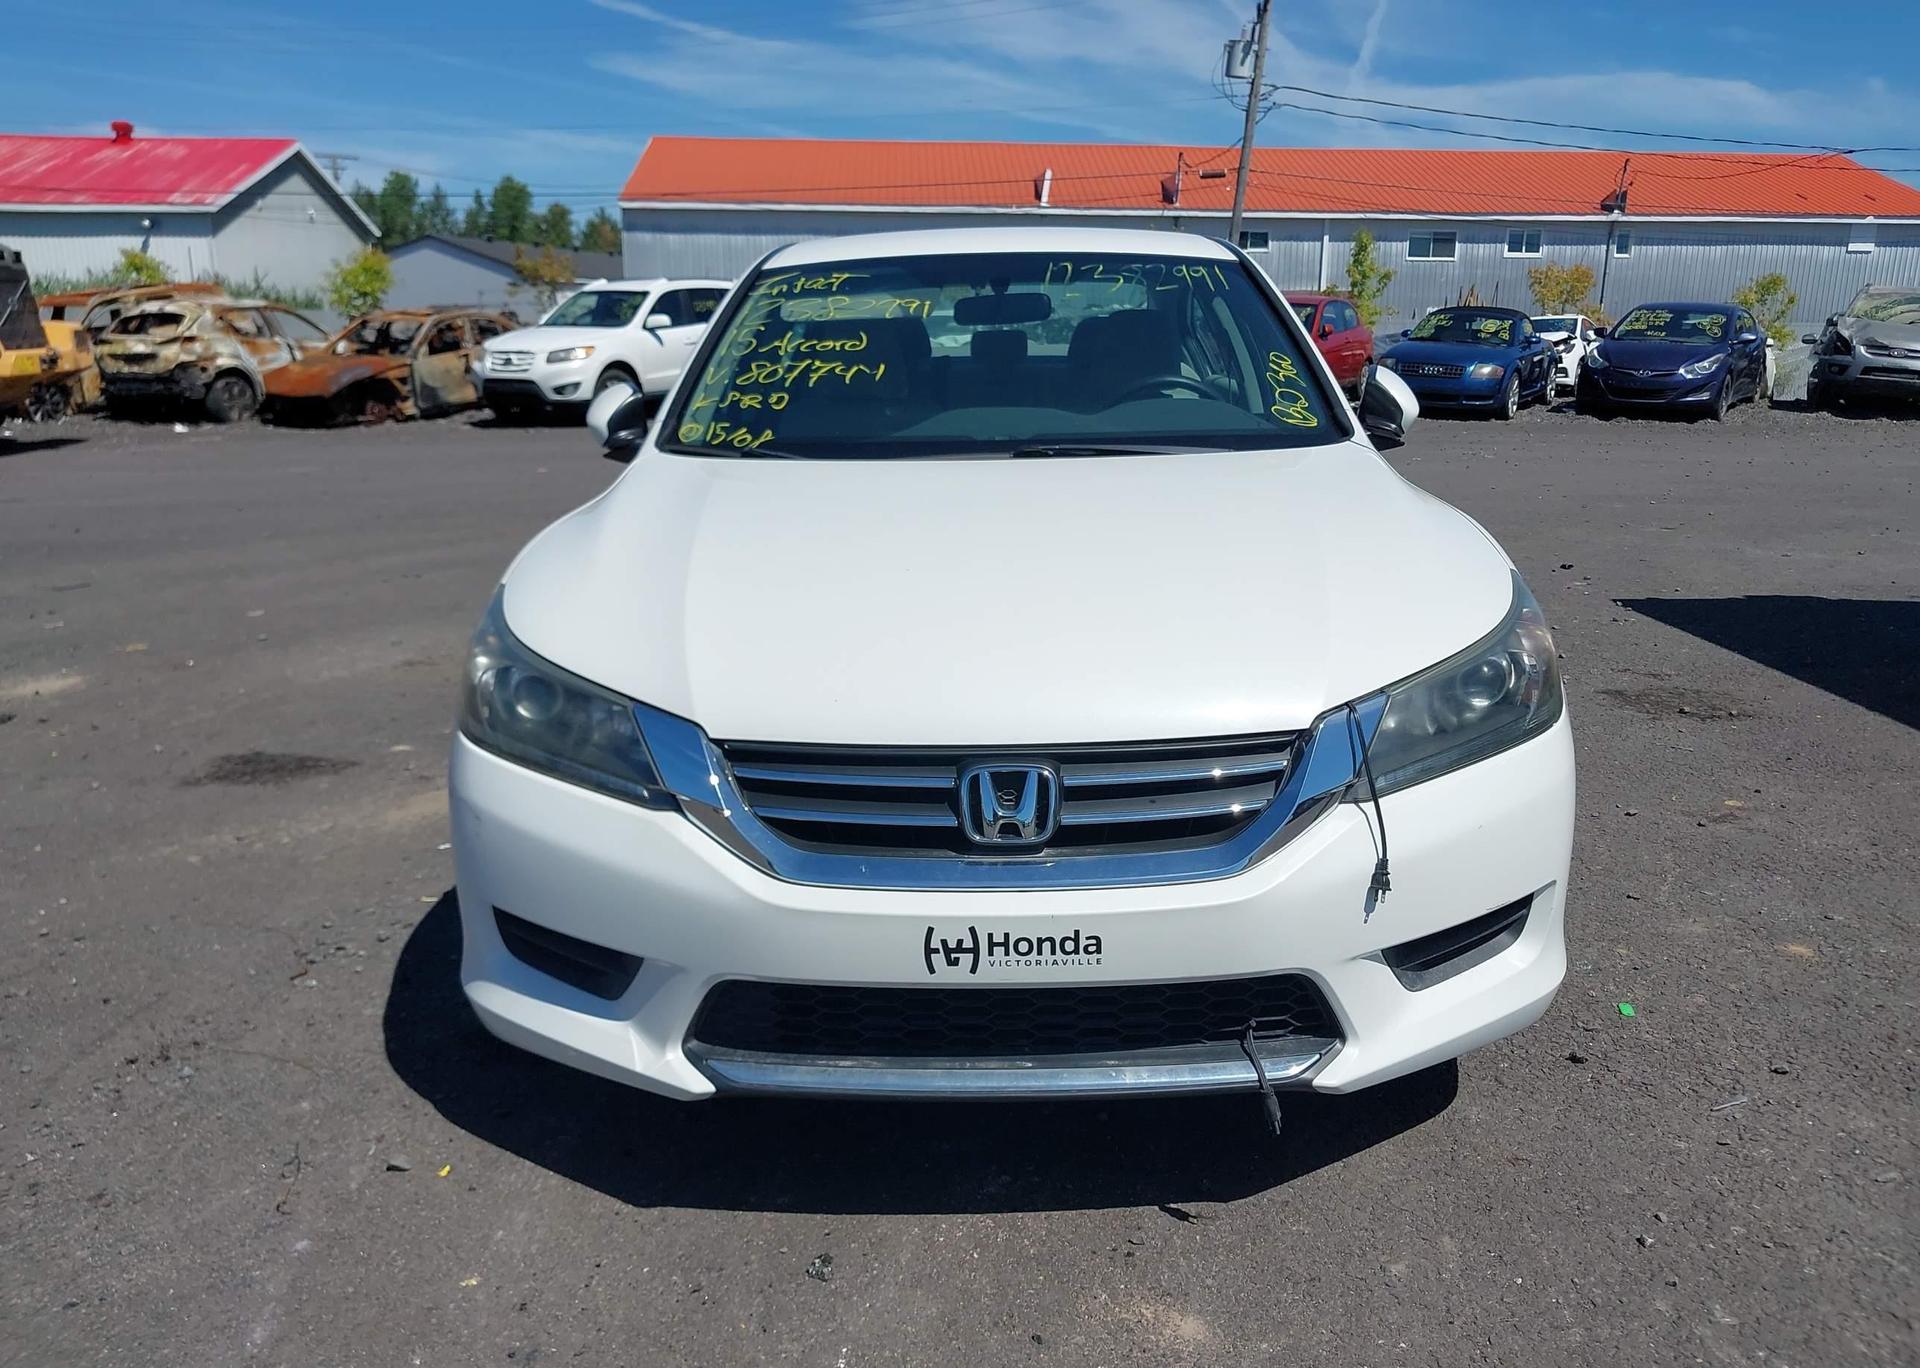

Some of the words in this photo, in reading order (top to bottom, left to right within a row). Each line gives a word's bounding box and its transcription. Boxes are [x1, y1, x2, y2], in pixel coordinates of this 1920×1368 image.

[758, 331, 867, 356] Accord
[987, 929, 1102, 956] Honda
[989, 958, 1102, 967] VICTORIAVILLE
